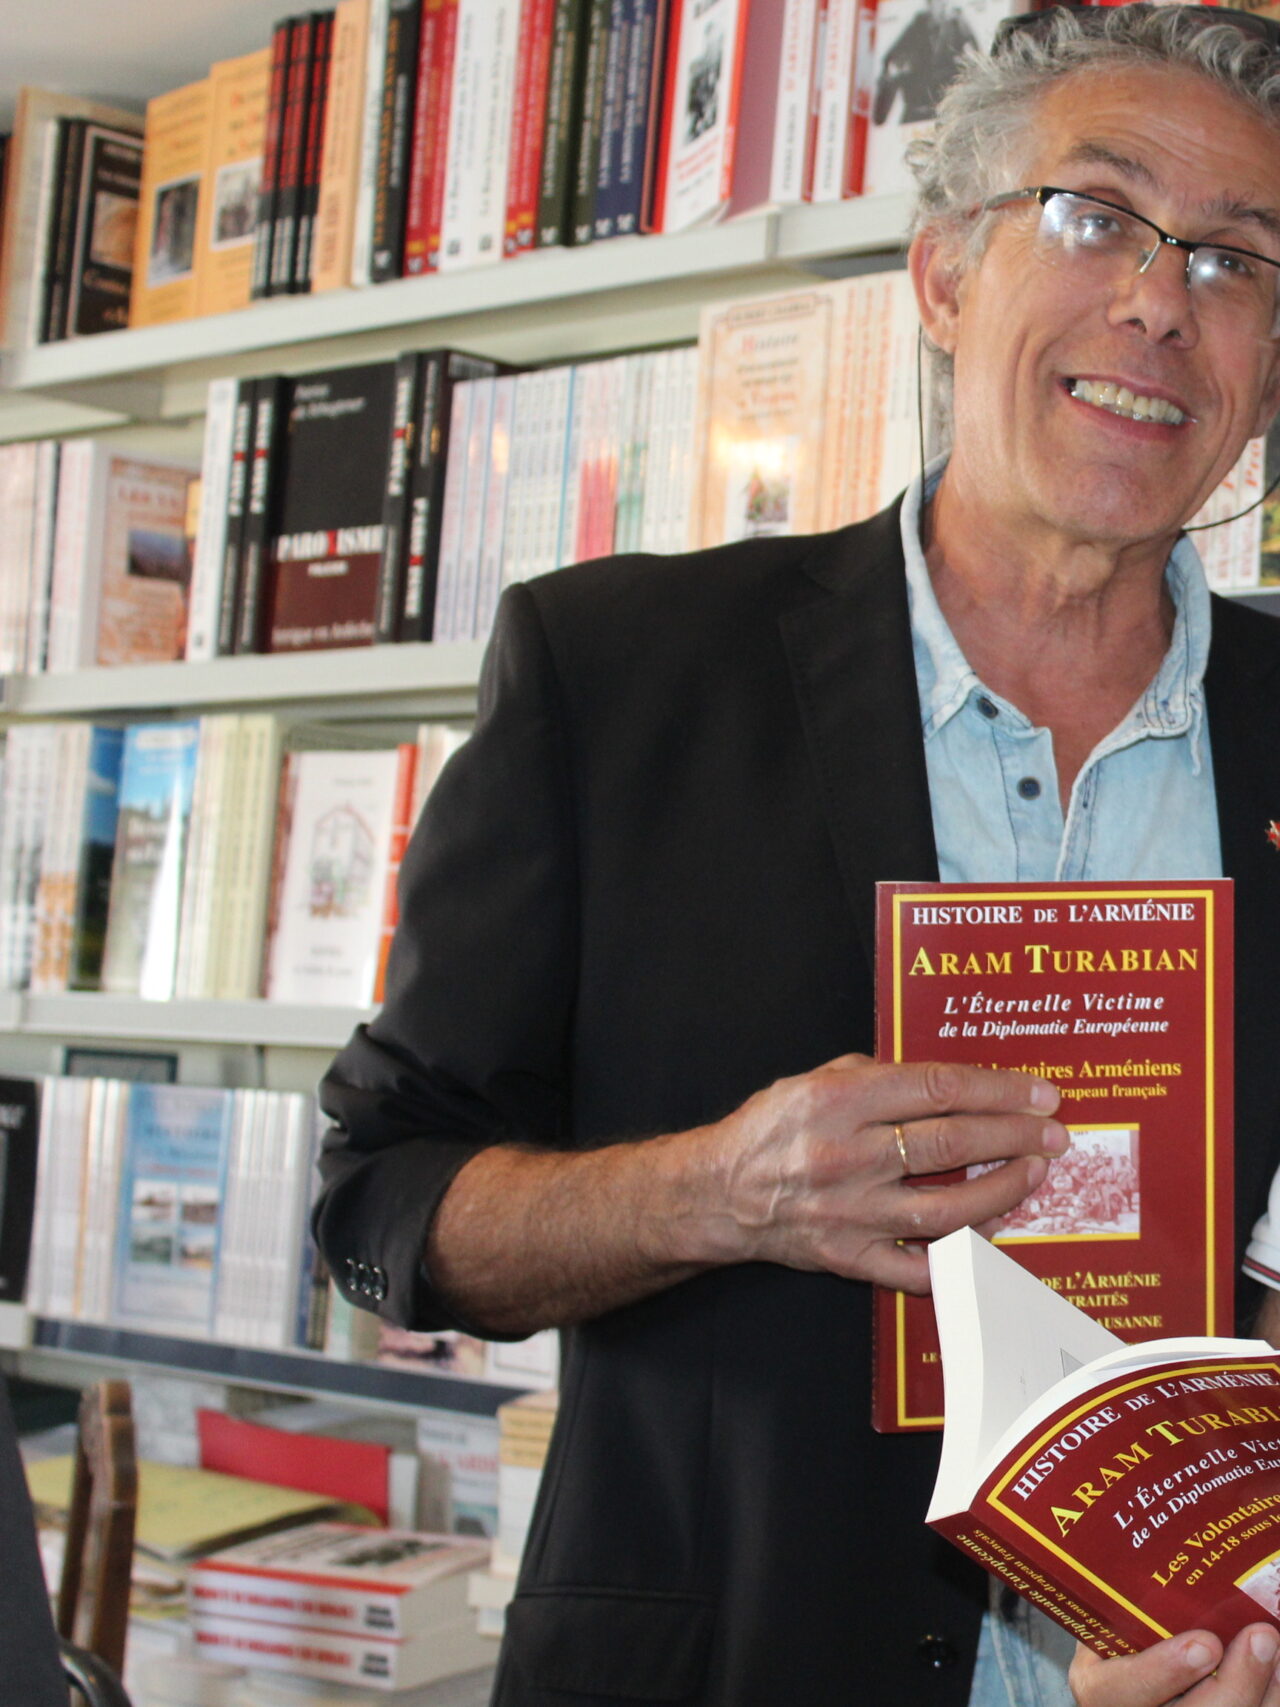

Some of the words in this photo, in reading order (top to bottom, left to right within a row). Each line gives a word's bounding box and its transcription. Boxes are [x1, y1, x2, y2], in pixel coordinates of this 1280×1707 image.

[912, 905, 1023, 925] HISTOIRE
[1033, 908, 1058, 924] DE
[1068, 899, 1195, 923] L'ARMÉNIE
[909, 946, 1013, 976] ARAM
[1024, 944, 1199, 974] TURABIAN
[943, 991, 1072, 1015] L'Éternelle
[1082, 993, 1165, 1012] Victime
[938, 1021, 958, 1038] de
[962, 1021, 978, 1038] la
[981, 1019, 1069, 1040] Diplomatie
[1073, 1018, 1169, 1036] Européenne
[1079, 1058, 1182, 1079] Arméniens
[1059, 1085, 1108, 1101] rapeau
[1112, 1083, 1168, 1100] français
[1065, 1271, 1161, 1290] L'ARMÉNIE
[1012, 1406, 1122, 1501] HISTOIRE
[1124, 1393, 1155, 1412] DE
[1154, 1371, 1280, 1399] L'ARMÉNIE
[1050, 1442, 1154, 1538] ARAM
[1113, 1448, 1238, 1530] L'Éternelle
[1132, 1527, 1151, 1549] de
[1148, 1511, 1169, 1529] la
[1166, 1461, 1255, 1515] Diplomatie
[1151, 1550, 1190, 1588] Les
[1185, 1567, 1204, 1586] en
[1200, 1535, 1241, 1569] 14-18
[1240, 1519, 1273, 1541] sous
[956, 1533, 1030, 1591] Européenne
[1028, 1589, 1096, 1641] Diplomatie
[1094, 1639, 1109, 1650] la
[973, 1528, 1016, 1562] français
[1014, 1559, 1057, 1592] drapeau
[1055, 1592, 1068, 1603] le
[1067, 1600, 1091, 1619] sous
[1086, 1616, 1117, 1640] 14-18
[1115, 1638, 1130, 1649] en
